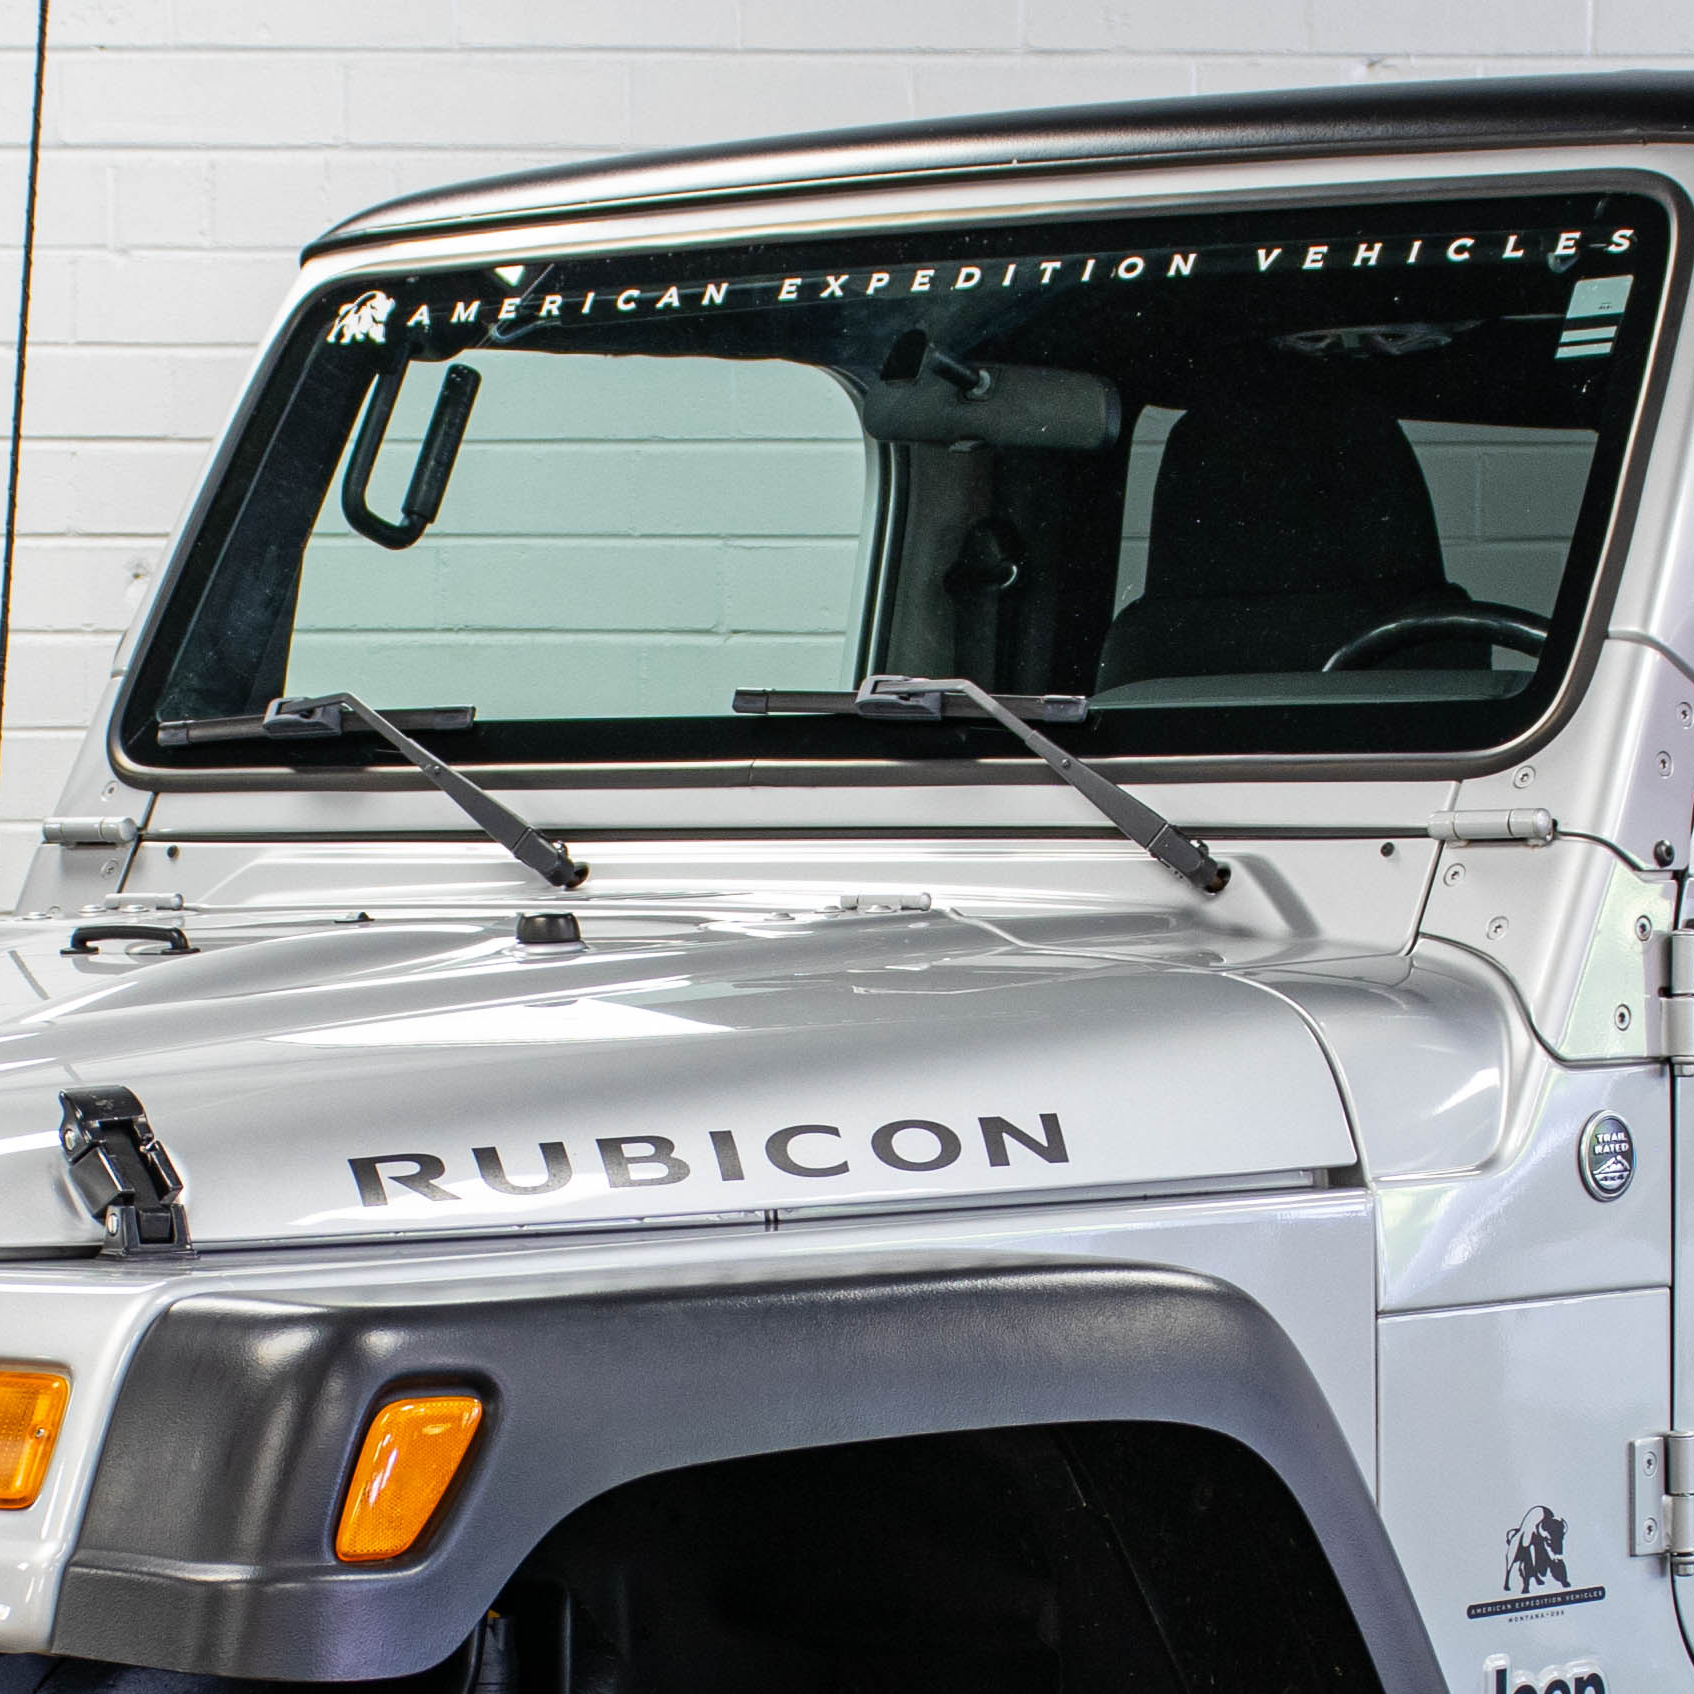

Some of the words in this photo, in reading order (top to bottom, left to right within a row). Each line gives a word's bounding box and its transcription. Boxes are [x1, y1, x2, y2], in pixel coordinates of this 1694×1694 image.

[406, 281, 730, 327] AMERICAN
[777, 252, 1198, 300] EXPEDITION
[1255, 228, 1635, 272] VEHICLES
[1596, 1133, 1628, 1143] TRAIL
[1595, 1144, 1629, 1154] RATED
[346, 1112, 1070, 1208] RUBICON
[1470, 1603, 1512, 1616] AMERICAN
[1514, 1596, 1562, 1609] EXPEDITION
